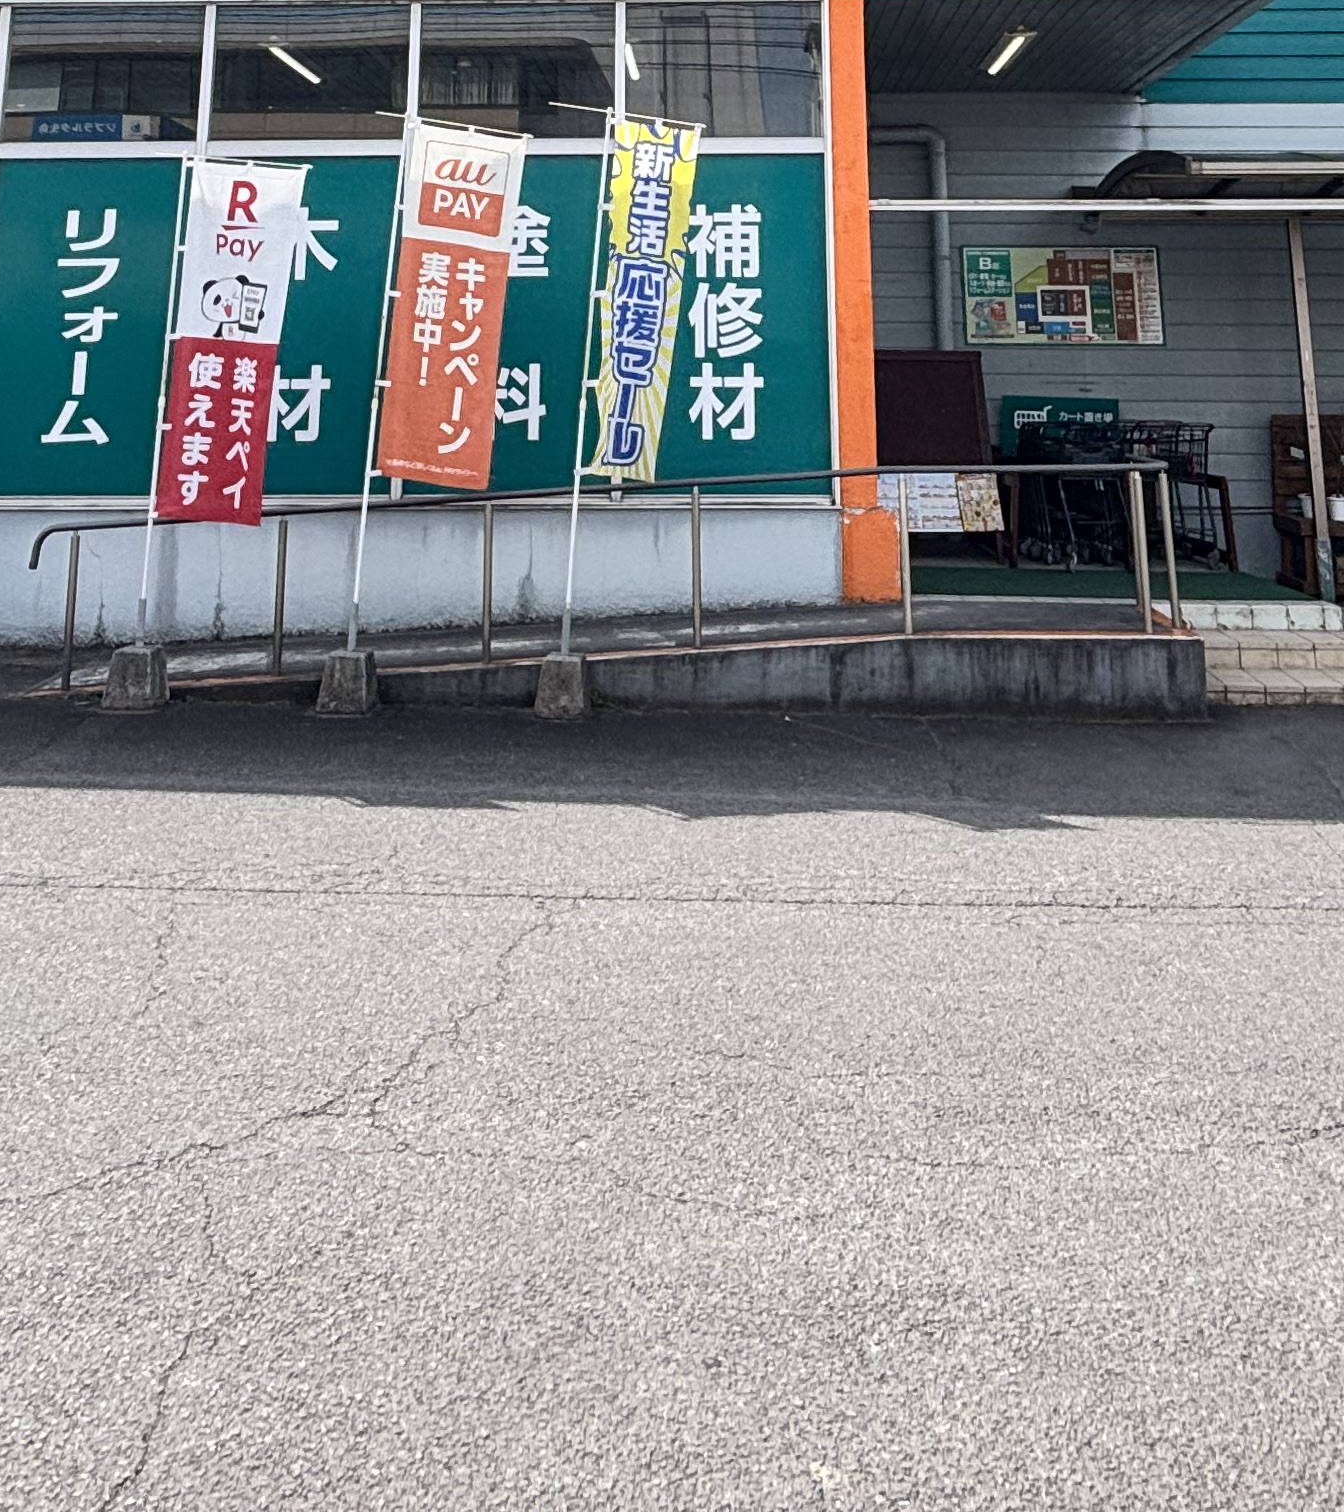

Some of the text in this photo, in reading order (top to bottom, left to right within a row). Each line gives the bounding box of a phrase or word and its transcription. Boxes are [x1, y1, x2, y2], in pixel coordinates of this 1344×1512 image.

[216, 233, 265, 262] Pay
[227, 180, 258, 223] R
[433, 188, 489, 220] PAY
[435, 159, 496, 186] au
[41, 209, 119, 445] リフォーム
[437, 257, 486, 454] キャンペーン
[688, 204, 764, 441] 補修材
[177, 352, 225, 506] 使えます
[222, 356, 258, 509] 楽天ペイ
